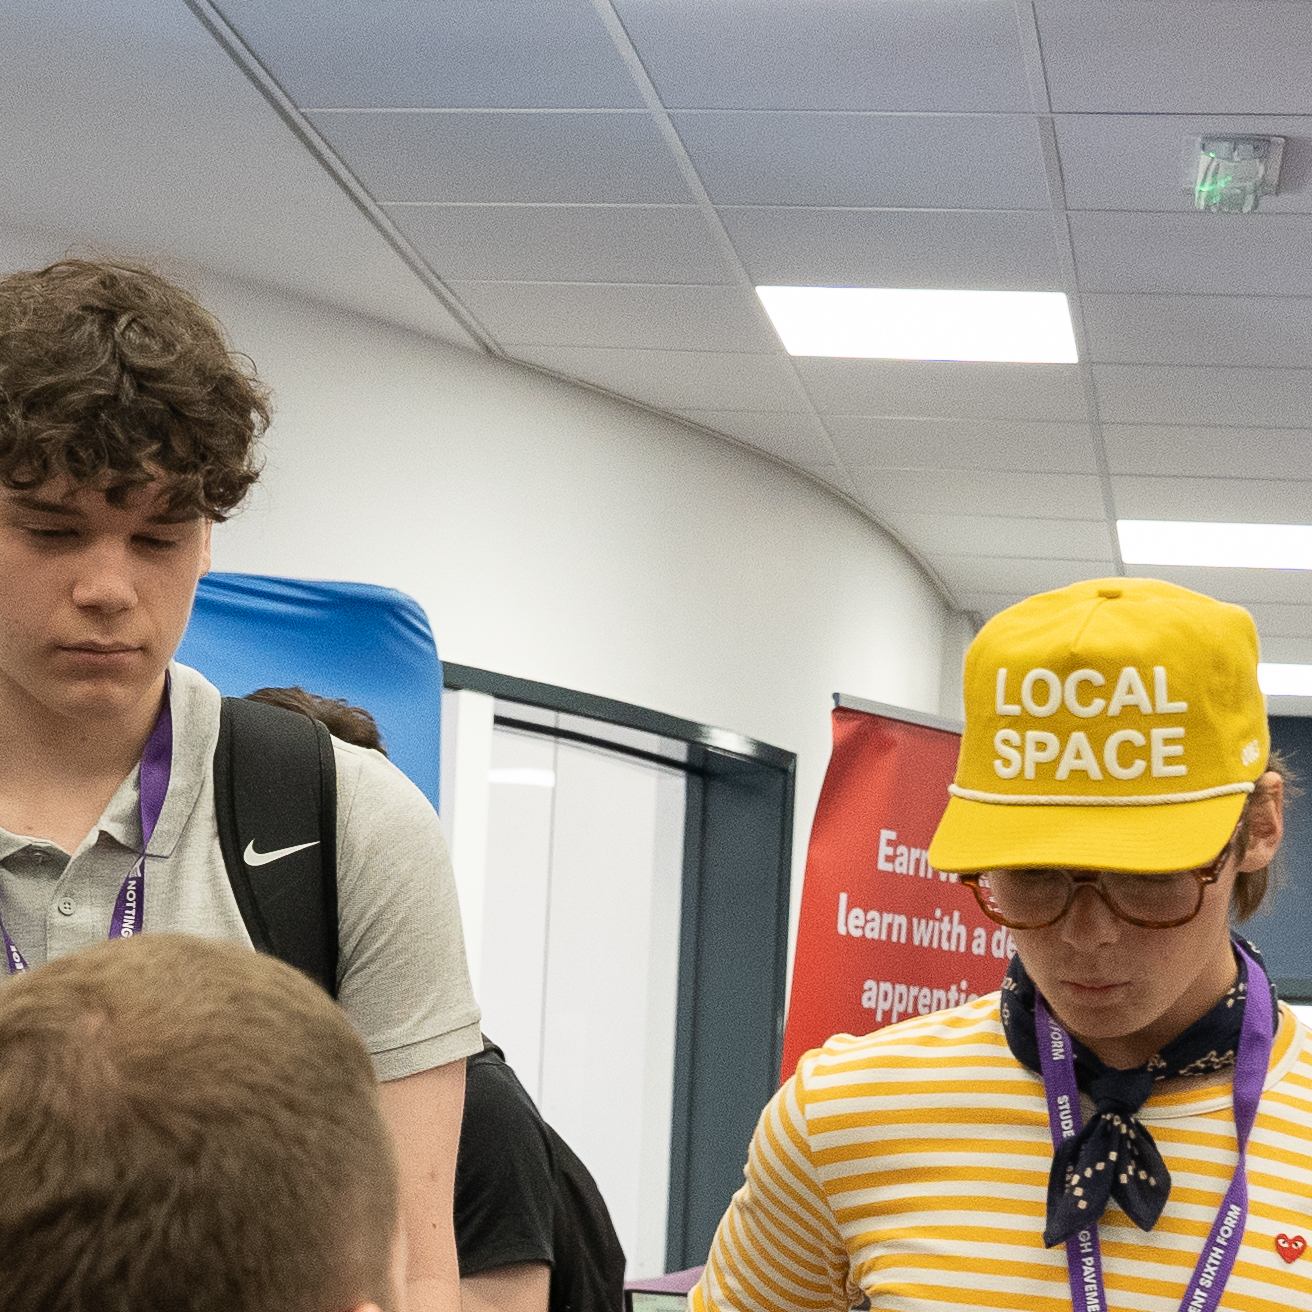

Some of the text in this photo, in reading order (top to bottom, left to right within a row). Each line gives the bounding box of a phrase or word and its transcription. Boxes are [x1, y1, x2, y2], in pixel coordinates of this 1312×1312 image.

[994, 666, 1187, 719] LOCAL
[993, 727, 1187, 780] SPACE
[877, 829, 933, 879] Earn
[837, 892, 907, 944] learn
[912, 908, 967, 953] with
[971, 927, 987, 956] a
[1198, 1245, 1225, 1289] SIXTH
[1215, 1204, 1243, 1246] FORM
